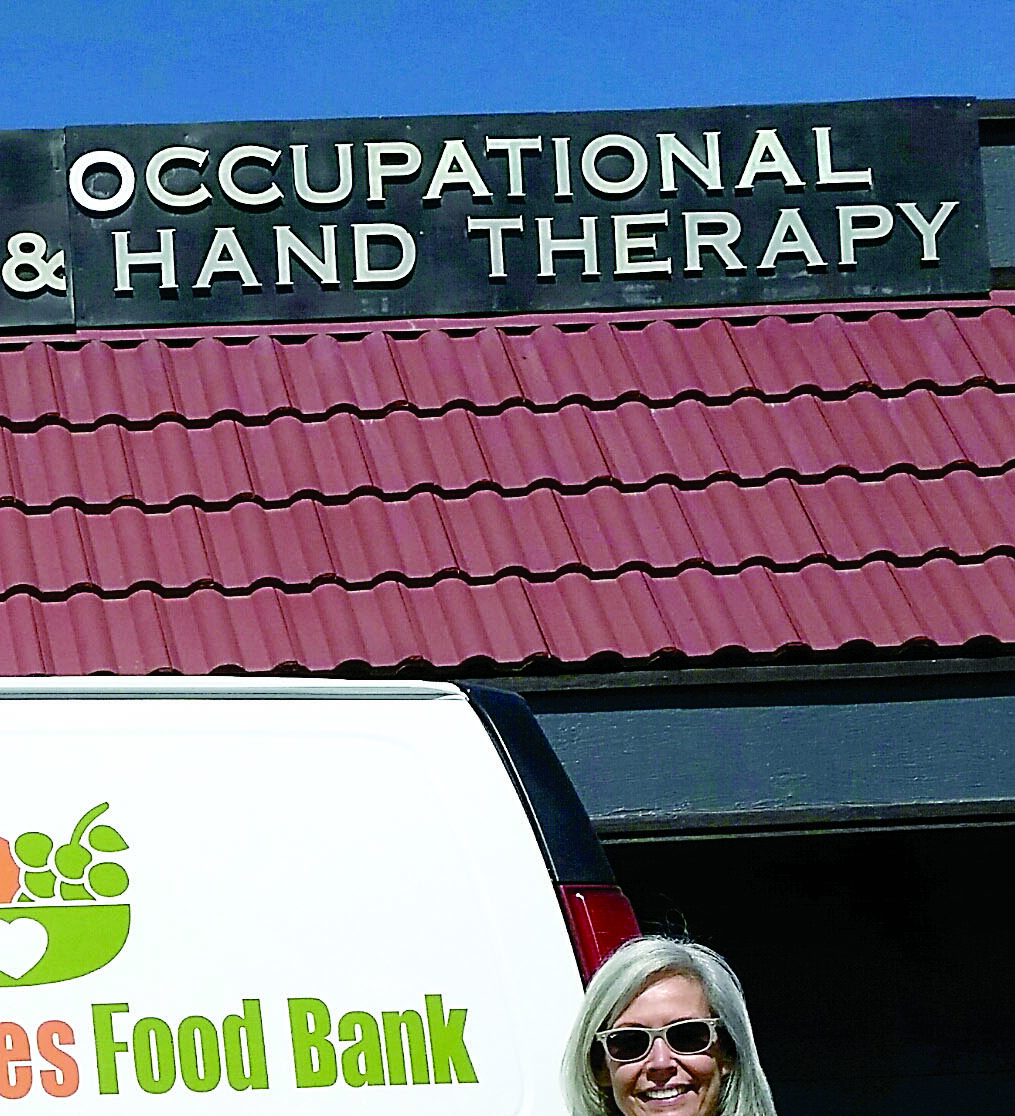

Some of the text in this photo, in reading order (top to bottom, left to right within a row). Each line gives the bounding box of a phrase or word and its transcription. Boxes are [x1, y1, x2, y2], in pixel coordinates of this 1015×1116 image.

[68, 126, 872, 212] OCCUPATIONAL
[1, 201, 960, 293] & HAND THERAPY
[91, 997, 269, 1096] Food
[287, 993, 480, 1089] Bank
